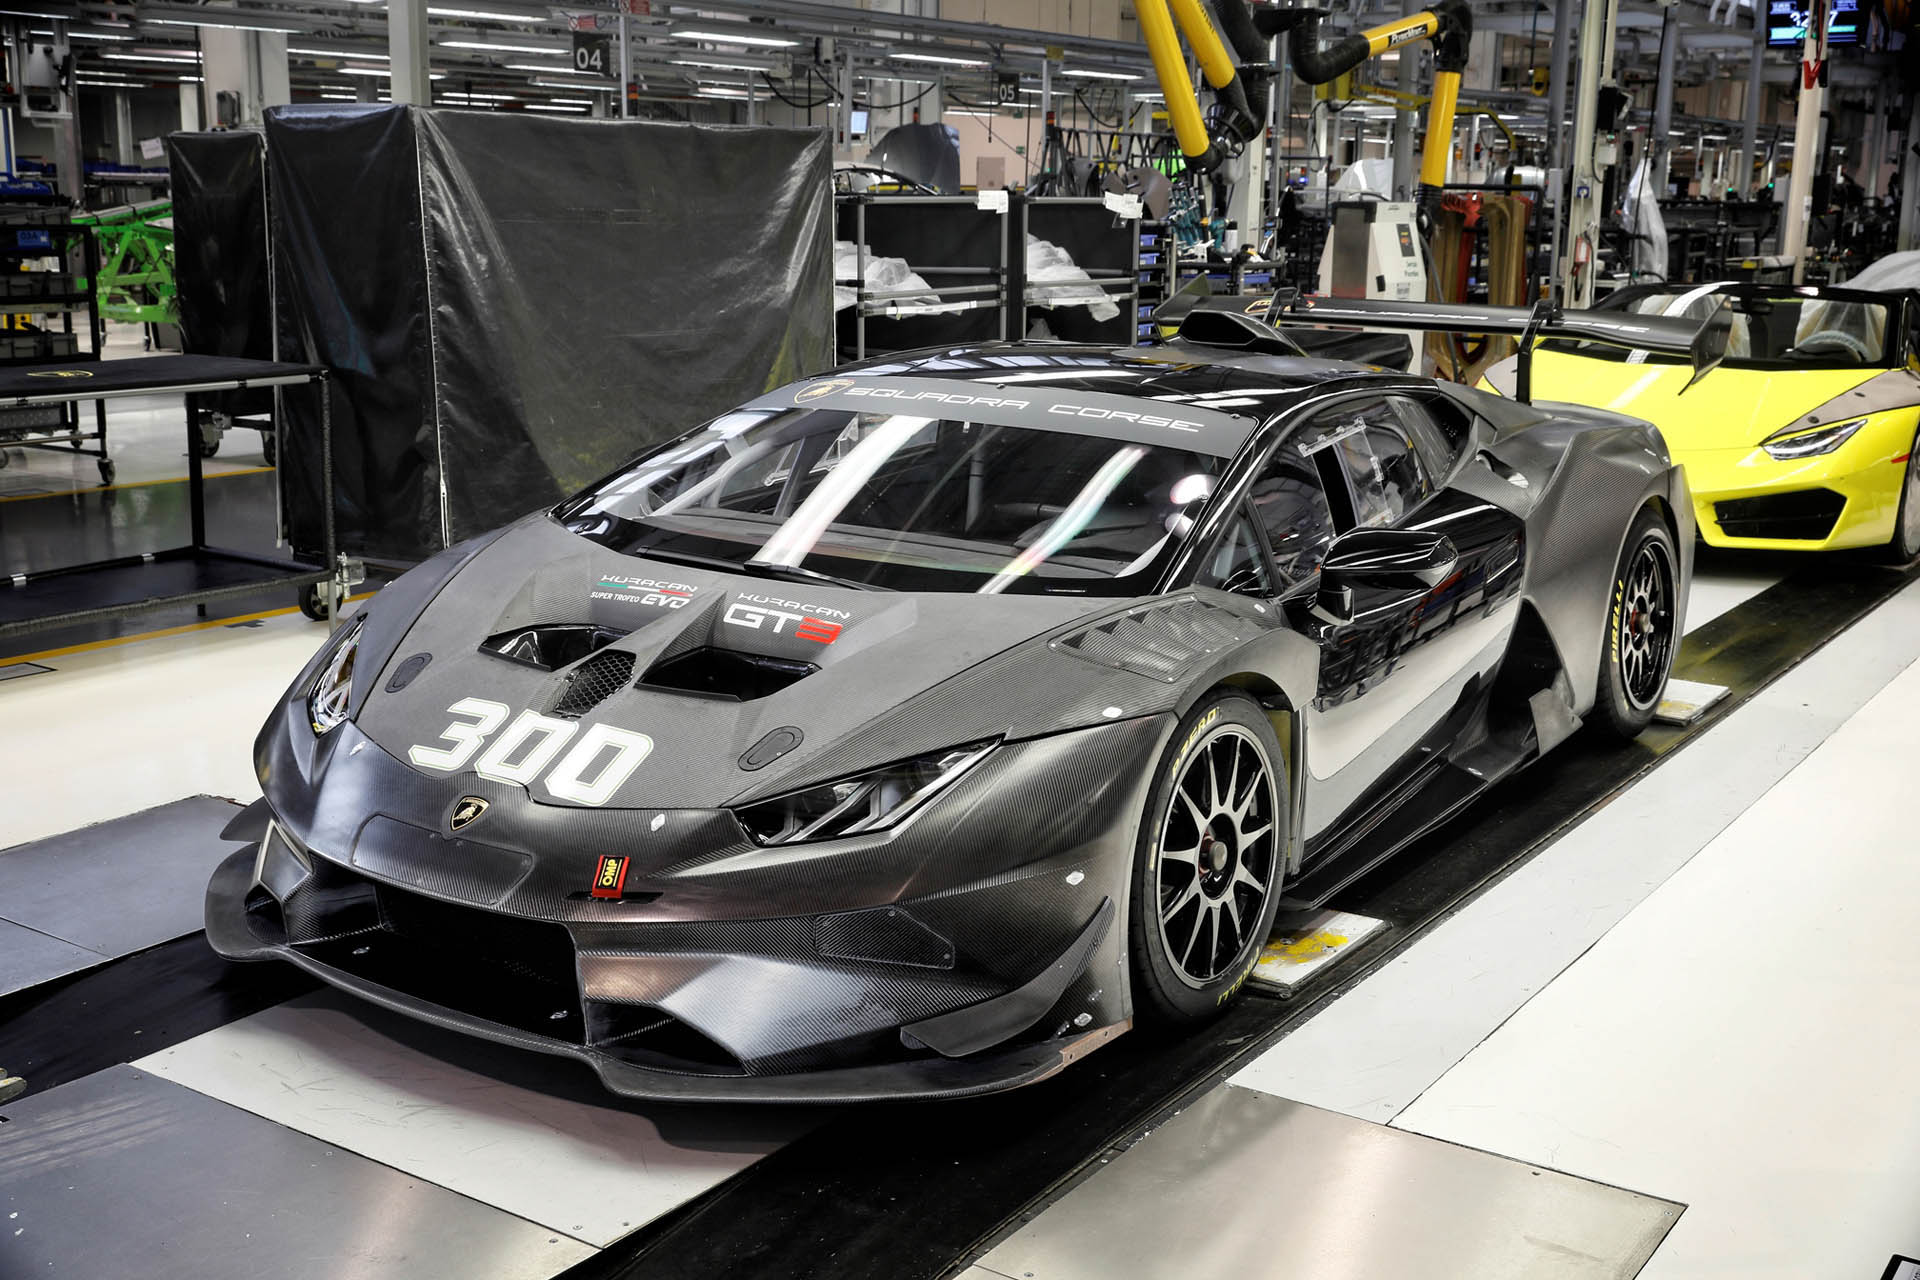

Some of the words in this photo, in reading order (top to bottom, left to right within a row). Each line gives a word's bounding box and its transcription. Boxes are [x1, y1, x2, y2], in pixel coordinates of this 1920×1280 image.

[576, 47, 603, 70] 04
[999, 84, 1015, 101] 05
[844, 387, 1031, 410] SQUADRA
[1048, 404, 1205, 432] CORSE
[600, 574, 698, 593] HURACAN
[590, 591, 613, 601] SUPER
[613, 593, 640, 603] TROFEO
[641, 593, 691, 609] EVO
[738, 592, 850, 619] HURACAN
[723, 602, 843, 645] GT3
[1611, 579, 1624, 663] PIRELLI
[407, 696, 654, 807] 300
[602, 858, 618, 886] OMP
